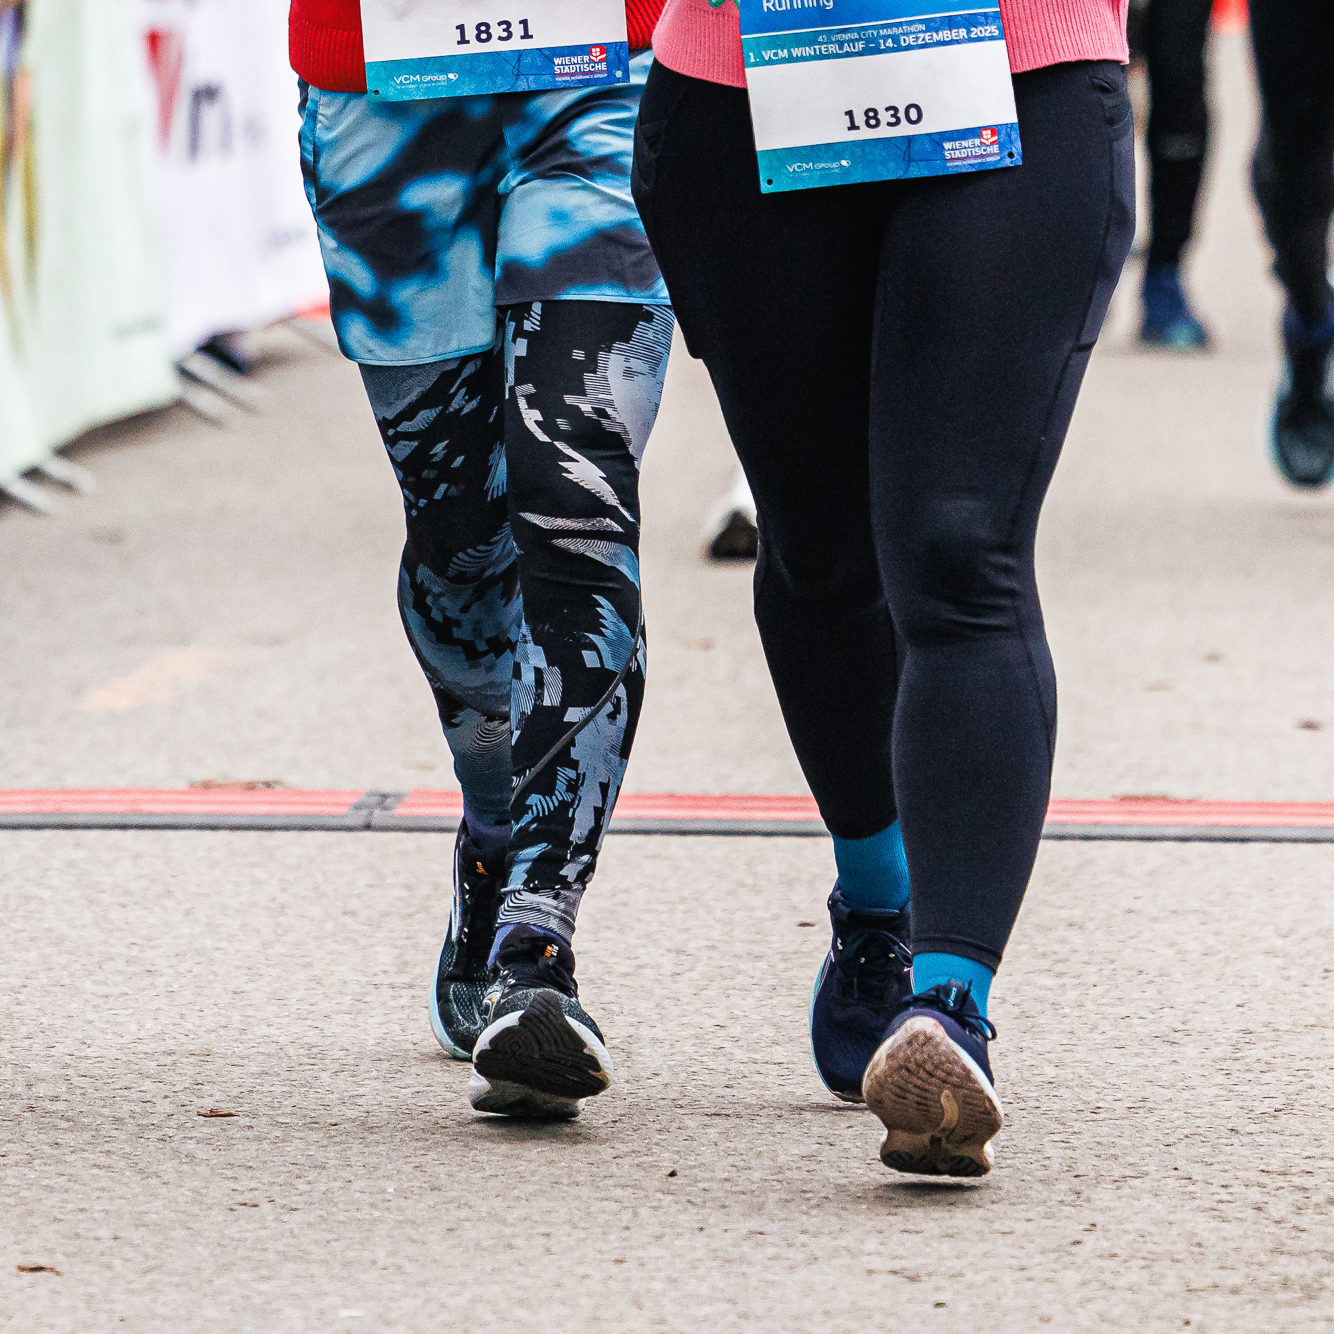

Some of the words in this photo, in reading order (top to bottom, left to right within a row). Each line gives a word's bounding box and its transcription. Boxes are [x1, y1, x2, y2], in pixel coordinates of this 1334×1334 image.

[455, 18, 534, 45] 1831
[831, 33, 859, 42] VIENNA
[860, 30, 878, 39] CITY
[879, 24, 926, 36] MARATHON
[749, 52, 759, 63] 1.
[762, 49, 788, 61] VCM
[791, 41, 866, 58] WINTERLAUF
[879, 38, 897, 49] 14.
[900, 28, 968, 47] DEZEMBER
[970, 25, 999, 38] 2025
[553, 55, 590, 65] WIENER
[393, 74, 421, 84] VCM
[421, 74, 447, 82] Group
[844, 103, 924, 131] 1830
[943, 138, 981, 151] WIENER
[786, 162, 814, 172] VCM
